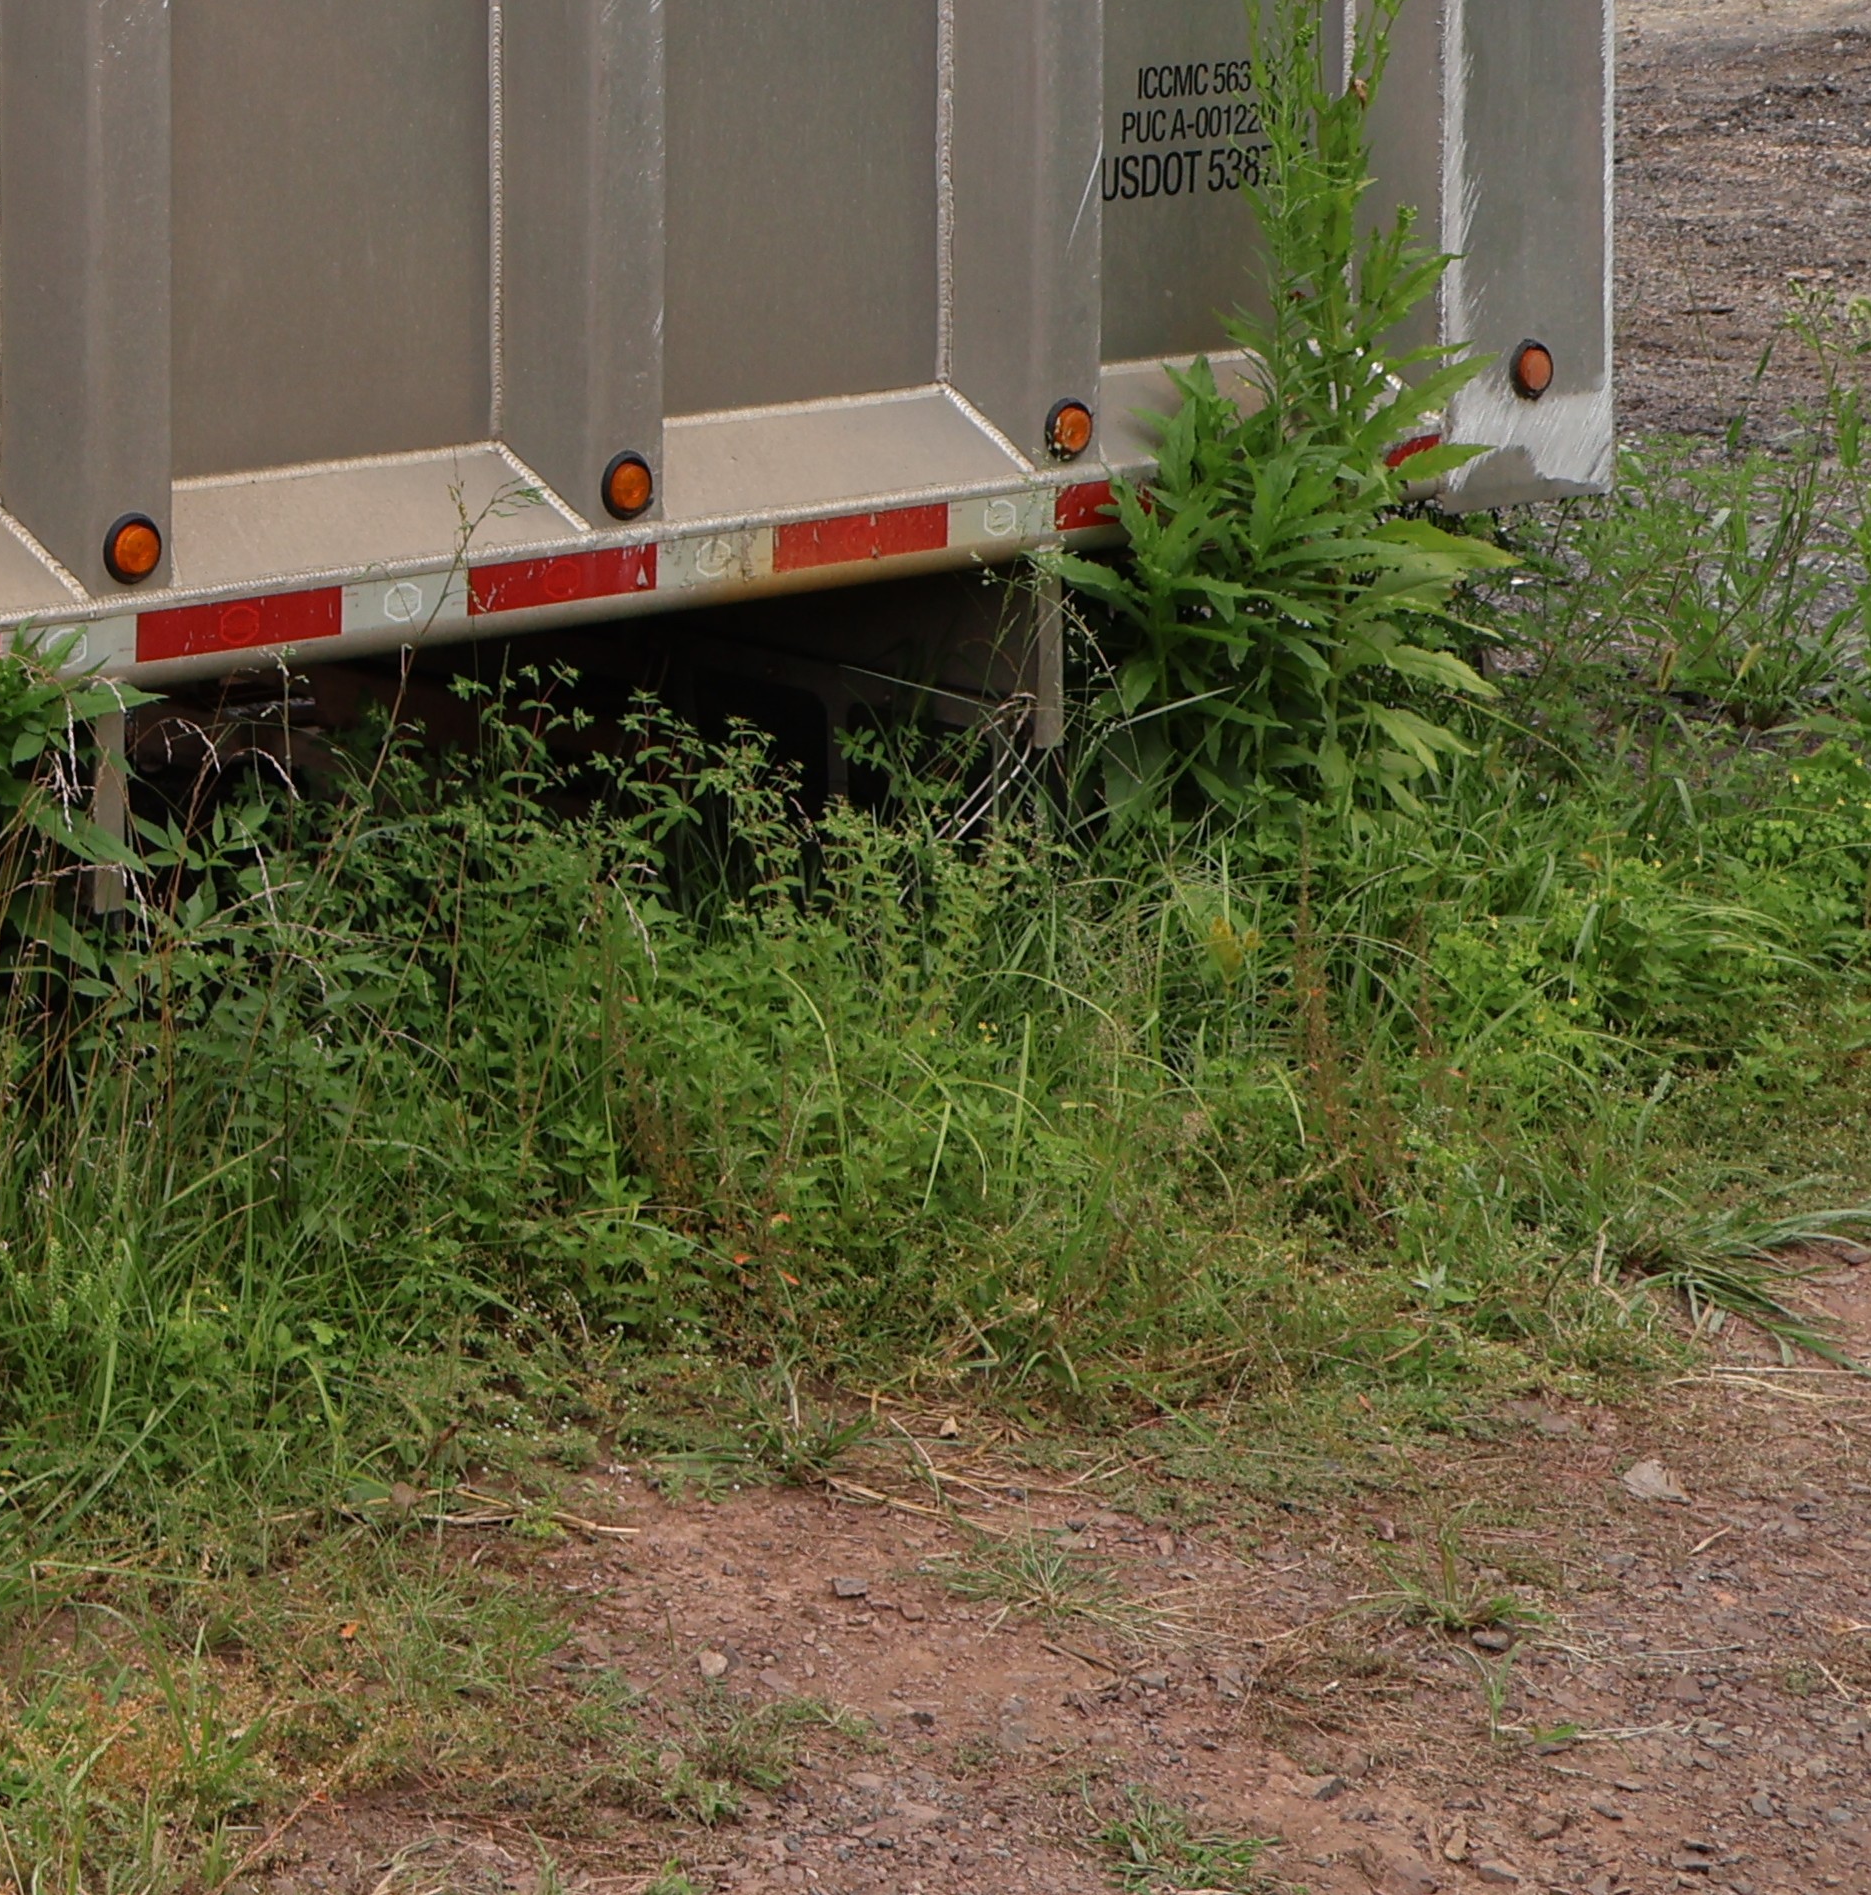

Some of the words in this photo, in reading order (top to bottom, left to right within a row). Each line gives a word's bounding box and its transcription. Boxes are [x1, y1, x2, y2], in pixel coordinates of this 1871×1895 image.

[1137, 63, 1208, 100] ICCMC
[1212, 59, 1276, 94] 563
[1121, 109, 1166, 144] PUC
[1101, 150, 1202, 202] USDOT
